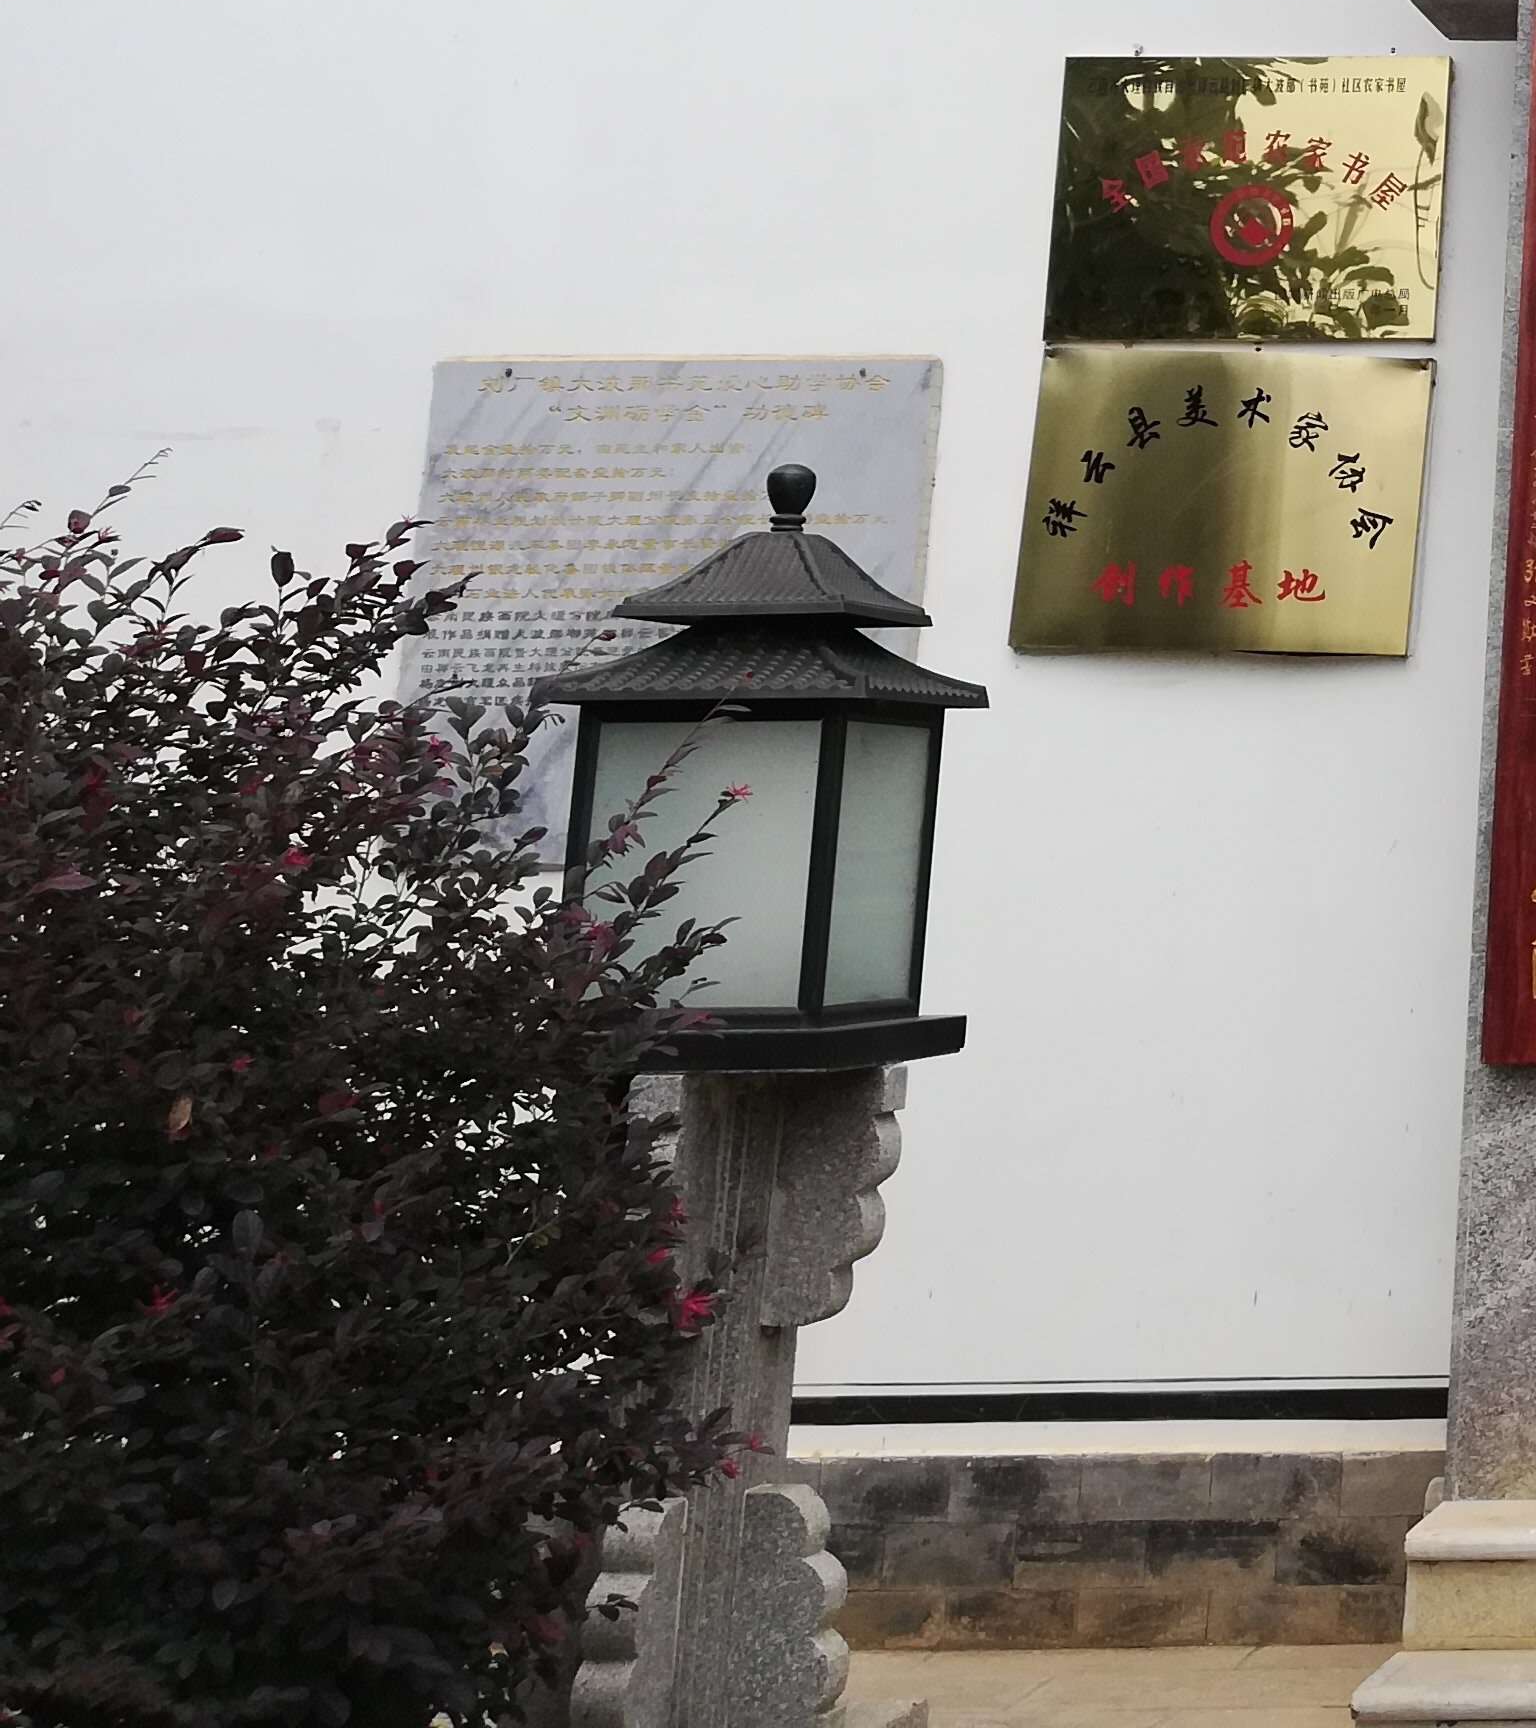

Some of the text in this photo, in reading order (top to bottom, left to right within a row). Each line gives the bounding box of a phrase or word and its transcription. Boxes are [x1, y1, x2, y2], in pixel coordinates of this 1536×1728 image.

[1100, 128, 1409, 213] 全国范农家书屋
[1090, 559, 1328, 610] 创作基地
